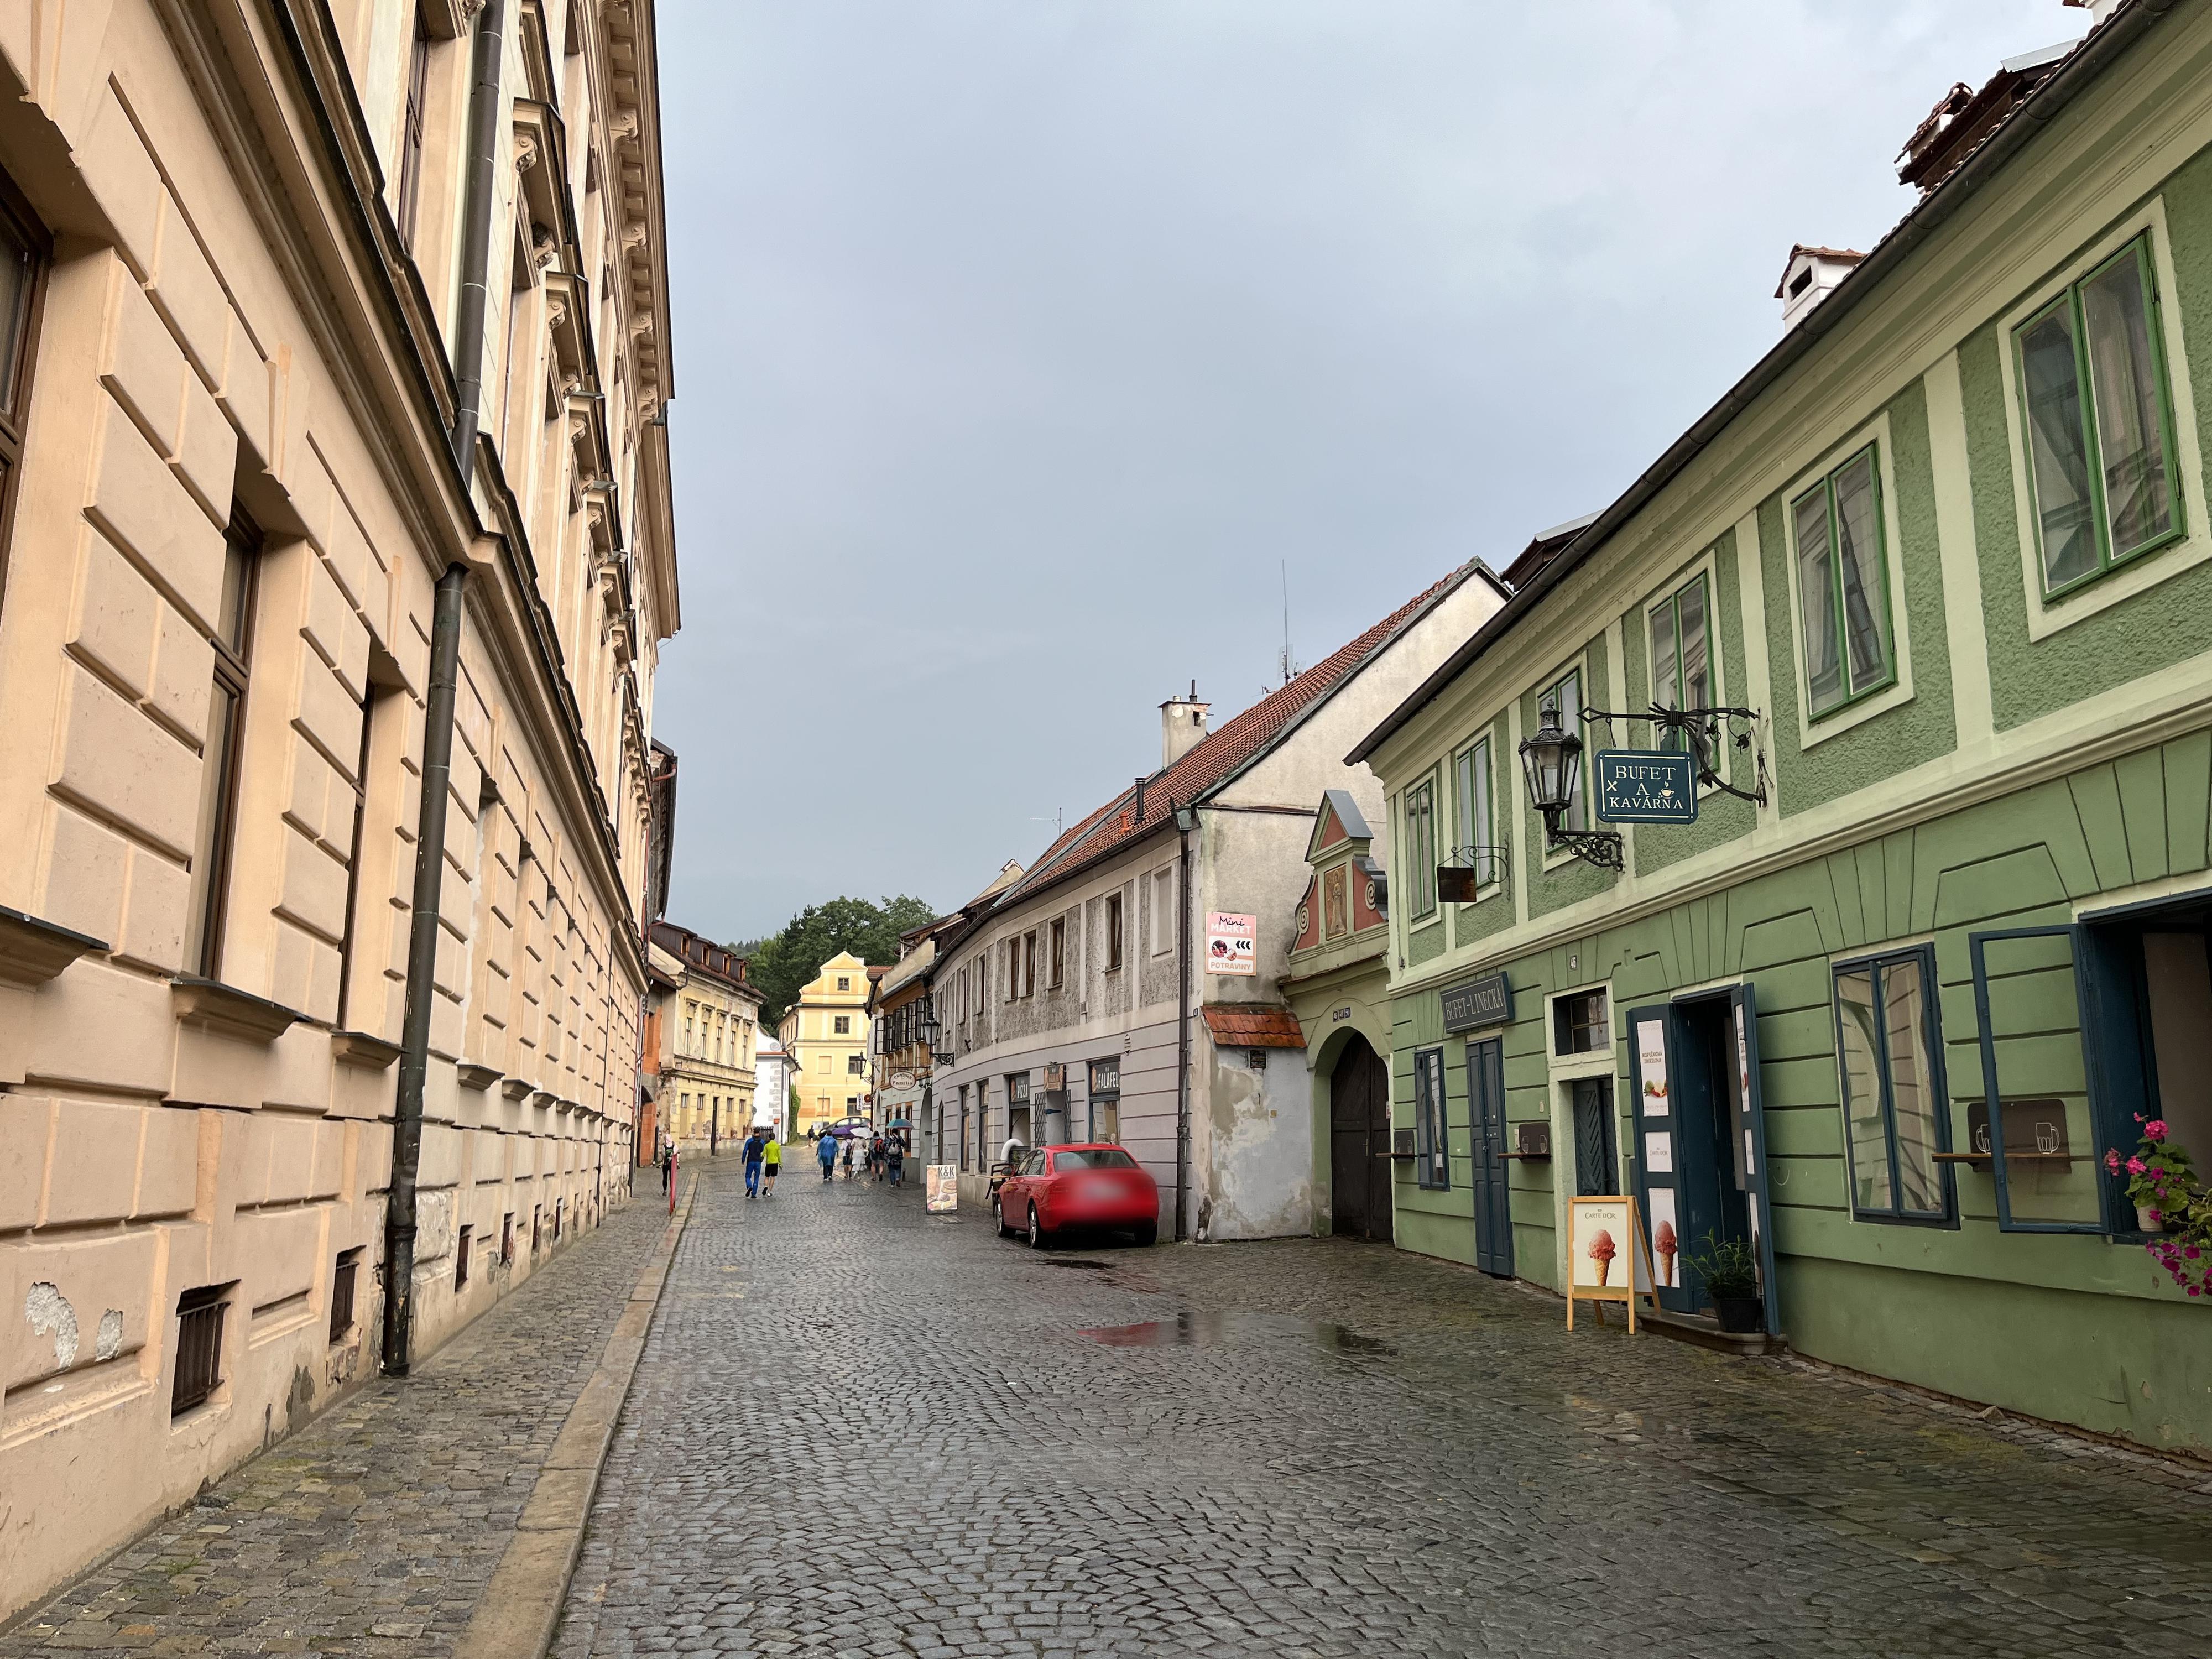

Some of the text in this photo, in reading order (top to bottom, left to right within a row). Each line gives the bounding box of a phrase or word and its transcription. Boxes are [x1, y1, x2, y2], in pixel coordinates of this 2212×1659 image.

[1615, 765, 1676, 780] BUFET
[1636, 782, 1650, 795] A
[1609, 796, 1683, 810] KAVÁRNA
[1219, 916, 1245, 926] Mini
[1211, 923, 1251, 935] MARKET
[1211, 962, 1251, 971] POTRAVINY
[1445, 982, 1503, 1021] BUFET-LINECKÁ
[1098, 1071, 1118, 1089] FALAFEL
[1018, 1084, 1028, 1098] PIZZA
[938, 1166, 955, 1177] K&K
